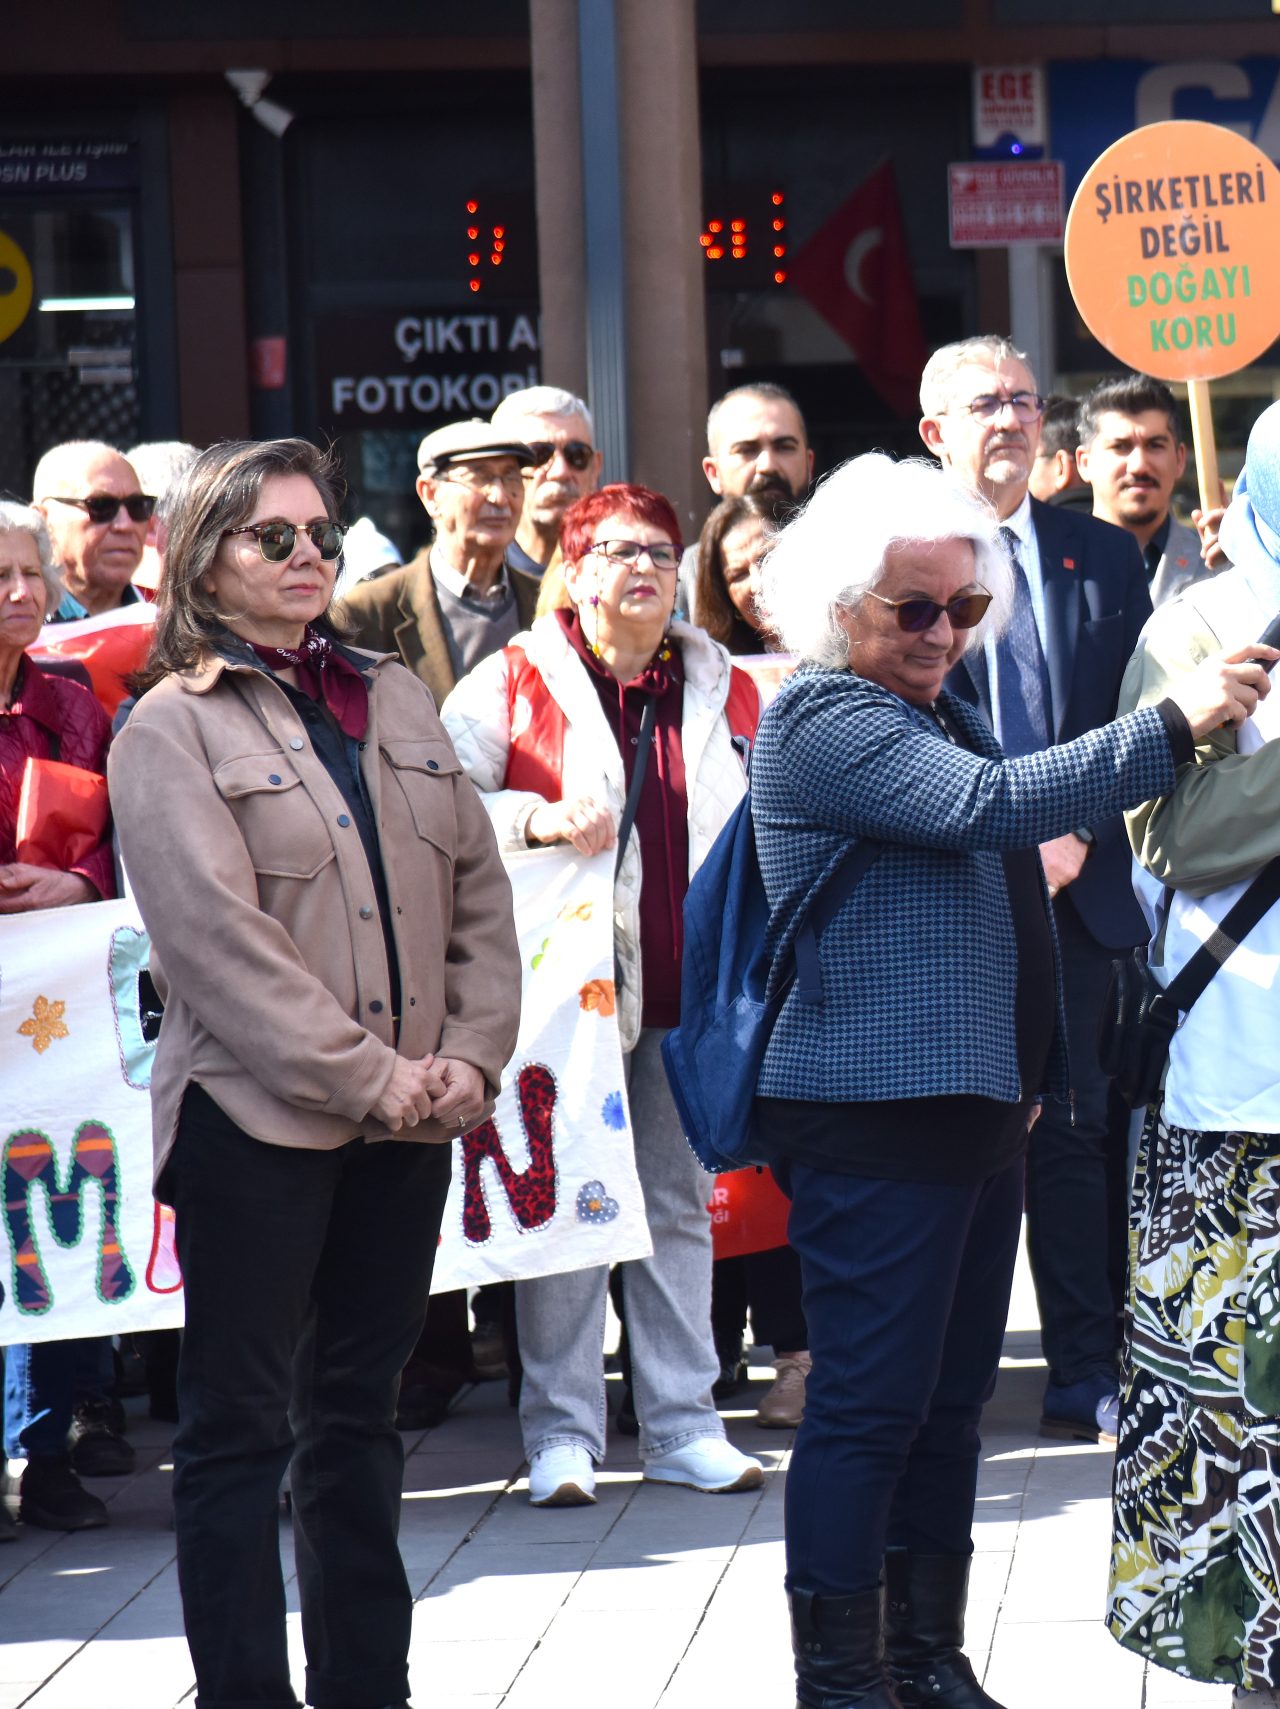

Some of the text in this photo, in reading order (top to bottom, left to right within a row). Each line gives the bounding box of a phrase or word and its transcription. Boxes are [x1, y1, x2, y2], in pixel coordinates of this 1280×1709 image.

[981, 73, 1034, 100] EGE
[36, 160, 88, 182] PLUS
[1095, 163, 1267, 224] ŞİRKETLERİ
[1140, 214, 1231, 259] DEĞİL
[1127, 262, 1251, 309] DOĞAYI
[395, 315, 542, 362] ÇIKTI A
[1150, 312, 1237, 352] KORU
